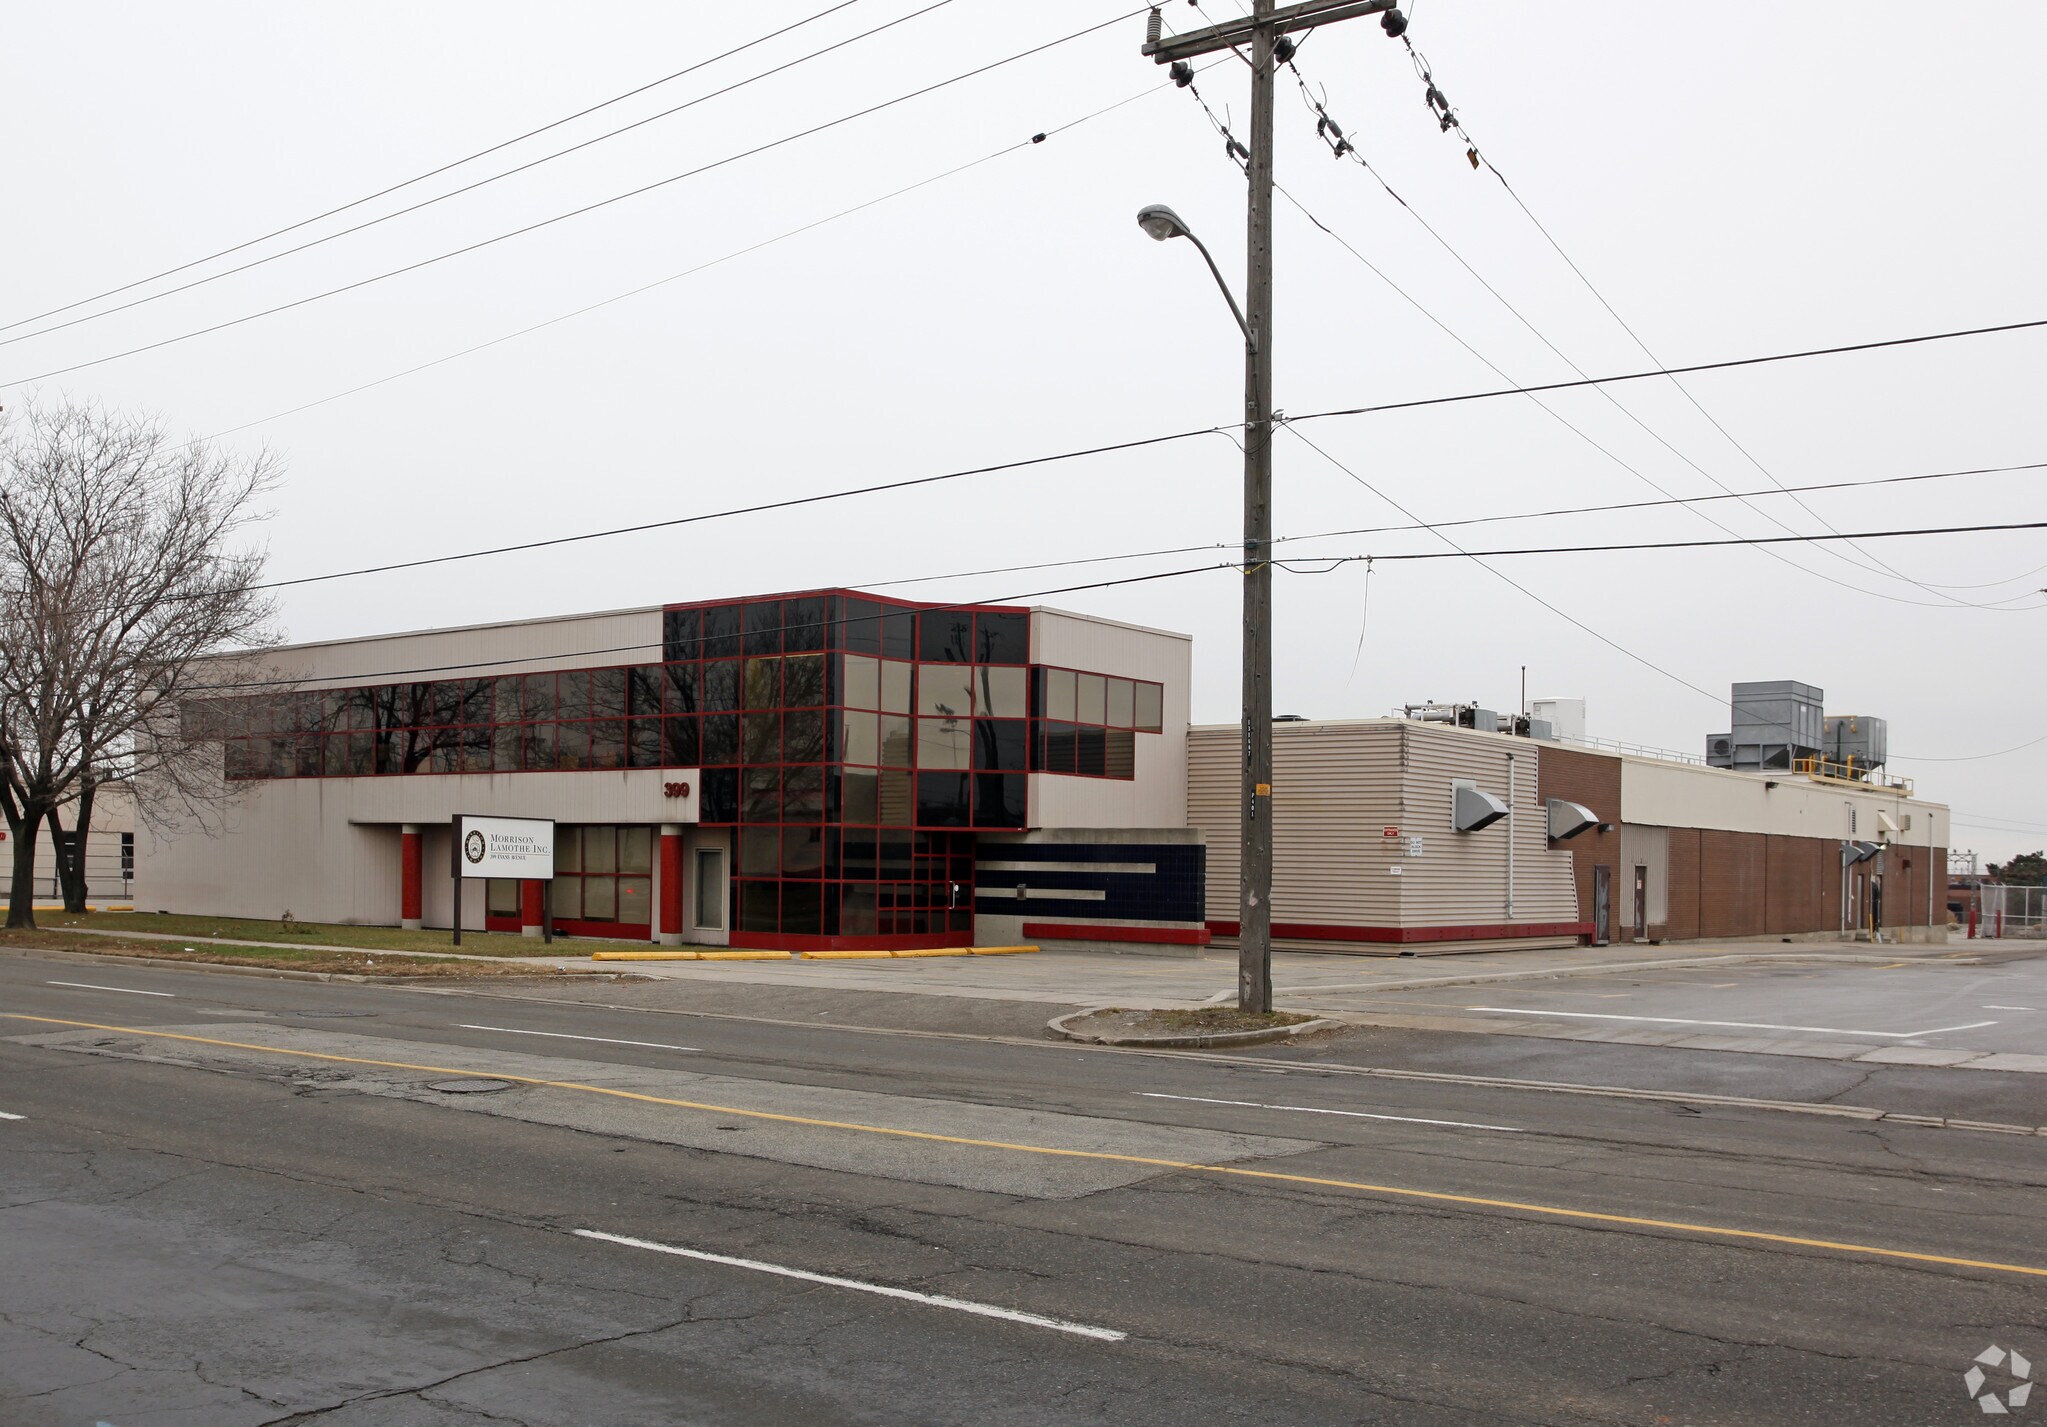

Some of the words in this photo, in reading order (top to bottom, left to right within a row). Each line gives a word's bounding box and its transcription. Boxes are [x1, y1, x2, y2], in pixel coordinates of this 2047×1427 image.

[664, 782, 690, 798] 399
[490, 834, 534, 844] MORRISON
[490, 843, 530, 853] LAMOTHE
[533, 844, 551, 854] INC.
